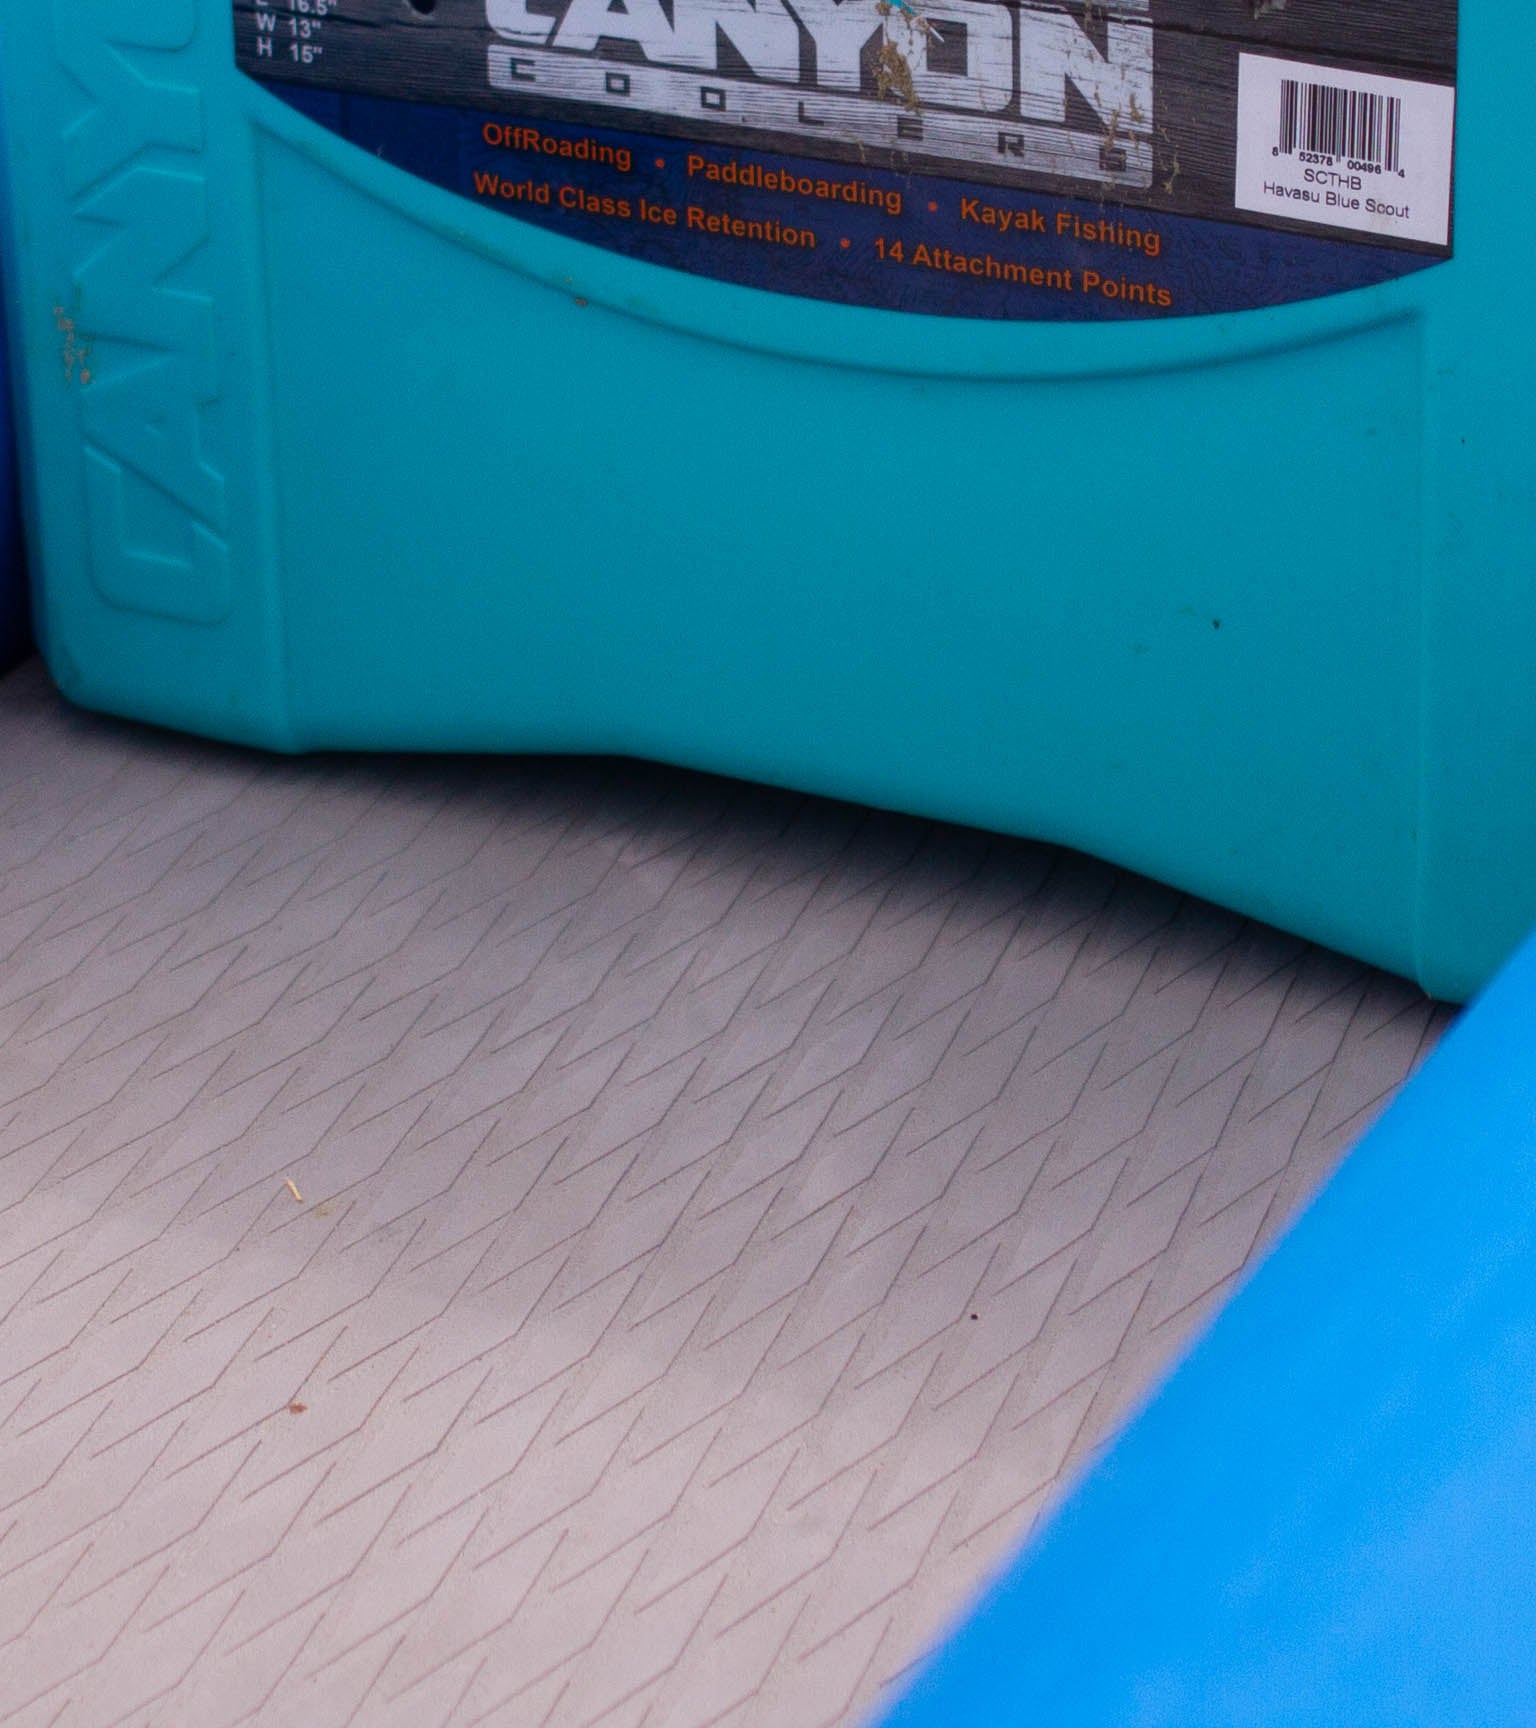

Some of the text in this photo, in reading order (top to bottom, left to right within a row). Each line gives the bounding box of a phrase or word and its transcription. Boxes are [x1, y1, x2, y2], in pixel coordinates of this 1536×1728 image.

[256, 12, 321, 38] W 13"
[256, 36, 323, 63] H 15"
[1299, 152, 1333, 166] 52378
[1347, 160, 1381, 175] 00496
[1398, 169, 1405, 178] 4
[482, 122, 1161, 256] OffRoading Paddleboarding Kayak Fishing
[1303, 168, 1362, 191] SCTHB
[1263, 181, 1410, 219] Havasu Blue Scout
[474, 172, 1172, 306] World Class Ice Retention 14 Attachment Points
